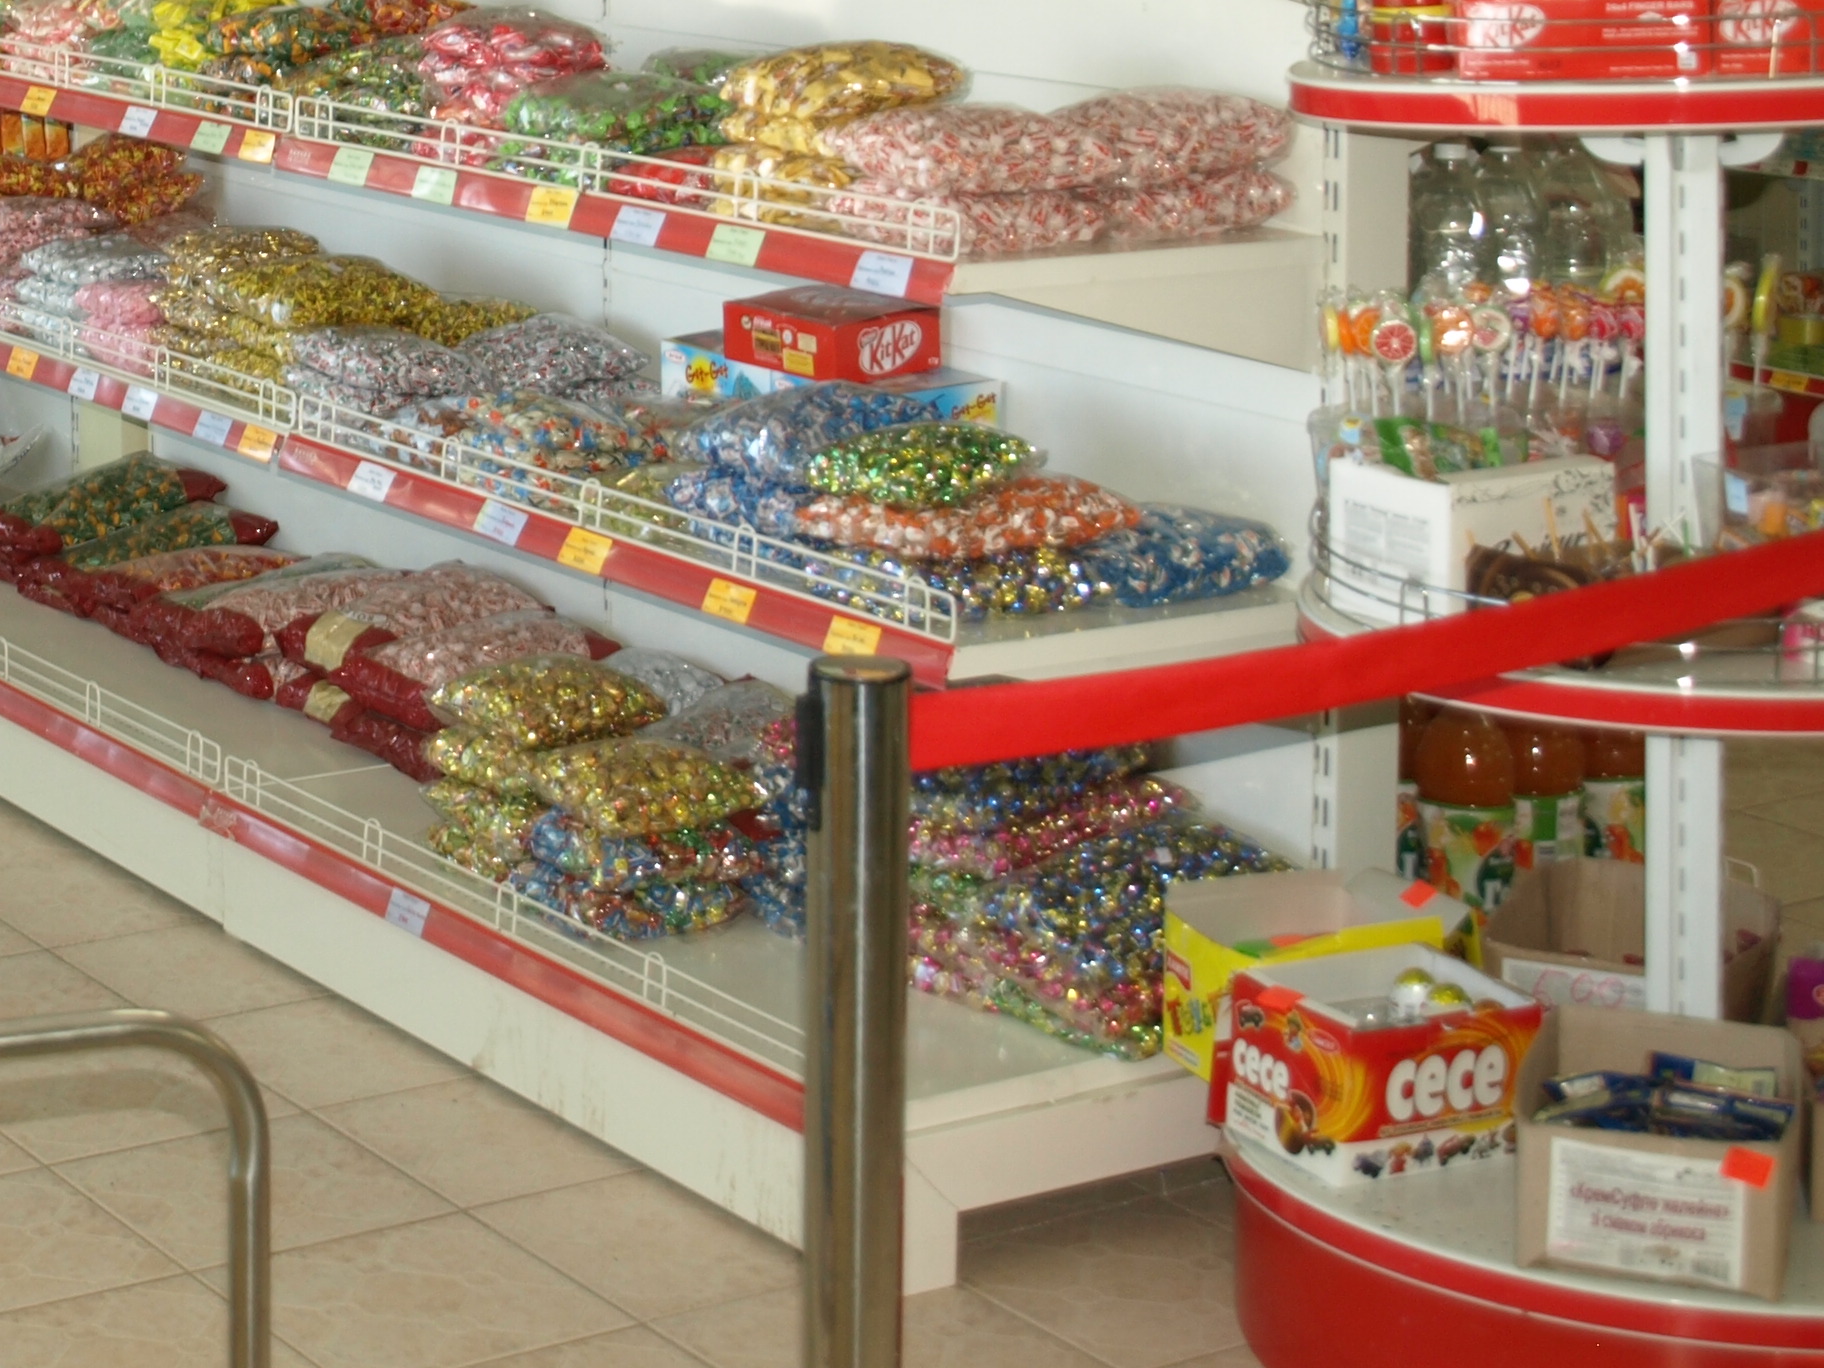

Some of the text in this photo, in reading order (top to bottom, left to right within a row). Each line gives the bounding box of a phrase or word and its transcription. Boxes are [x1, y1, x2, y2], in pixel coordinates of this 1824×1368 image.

[868, 322, 918, 372] KitKat
[1232, 1037, 1290, 1100] cece
[1385, 1044, 1508, 1121] cece
